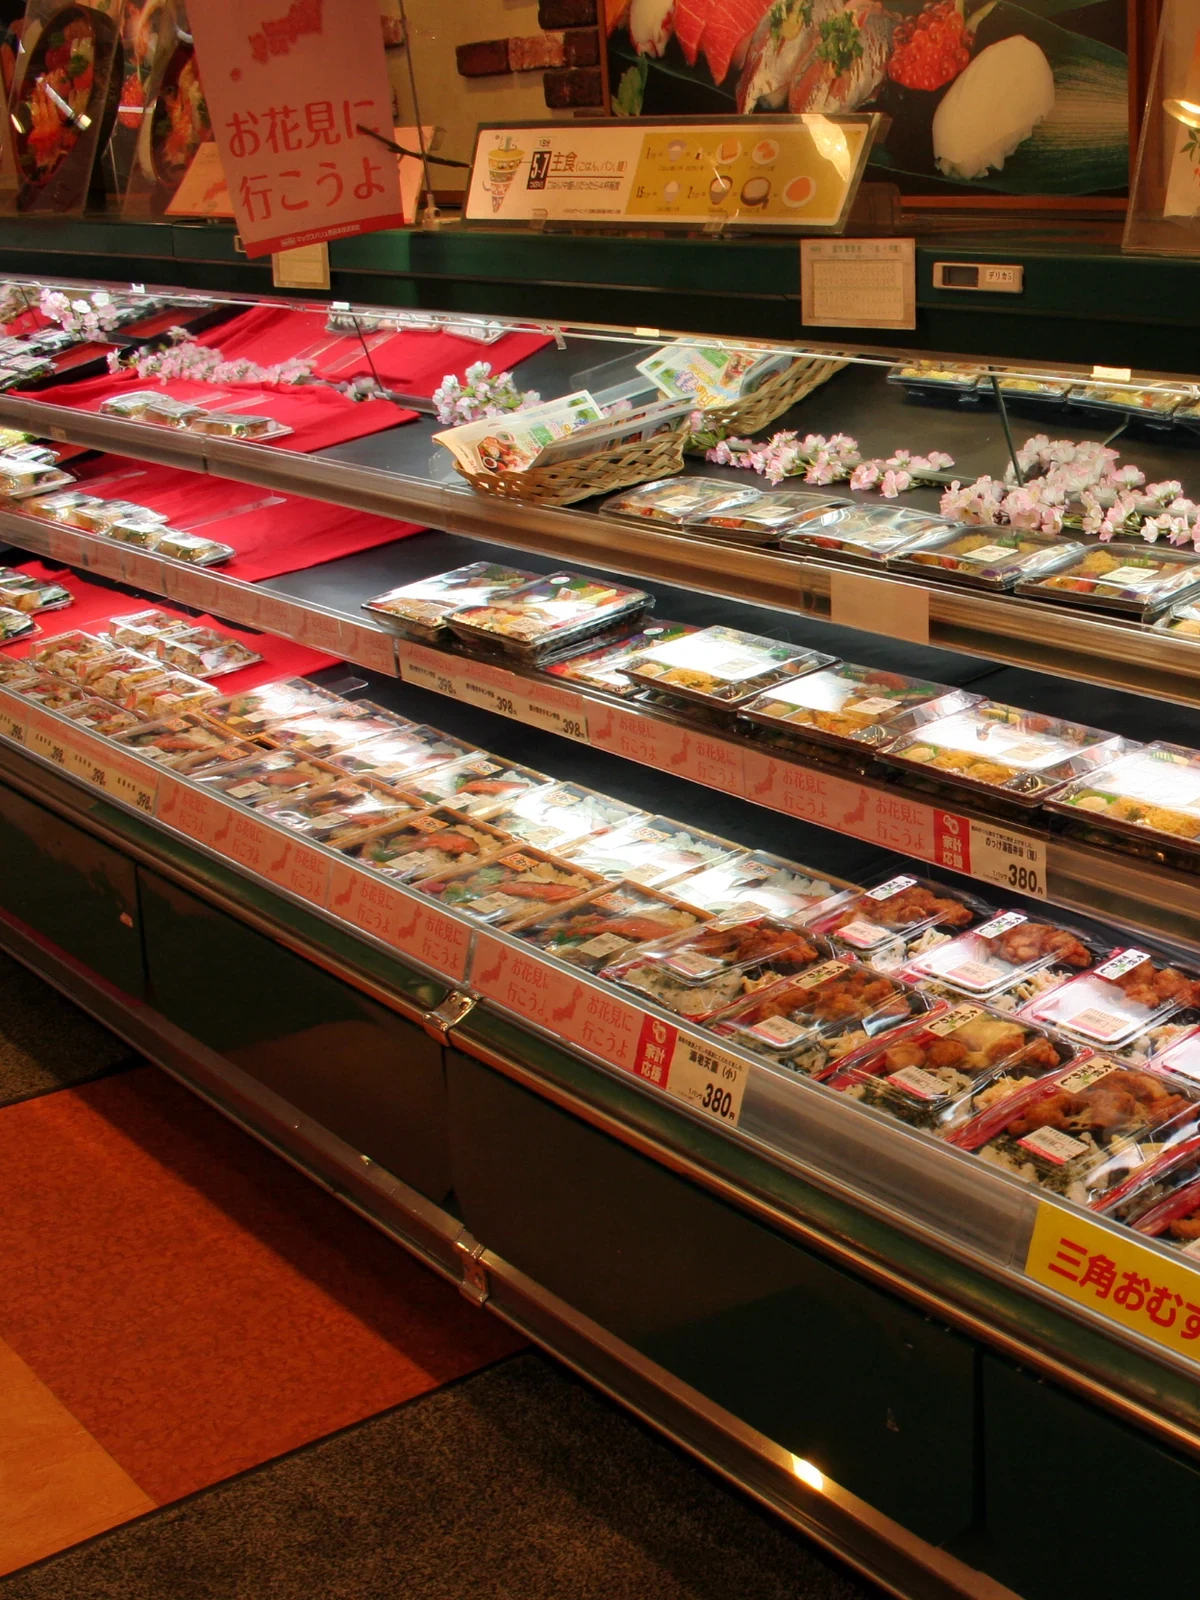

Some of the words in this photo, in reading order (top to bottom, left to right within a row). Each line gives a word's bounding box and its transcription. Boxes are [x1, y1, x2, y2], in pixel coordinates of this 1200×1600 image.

[225, 99, 380, 158] お花見に
[239, 157, 385, 223] 行こうよ
[942, 835, 963, 852] 家計
[587, 994, 634, 1032] お花見に
[582, 1020, 630, 1059] 行こうよ
[645, 1043, 665, 1064] 家計
